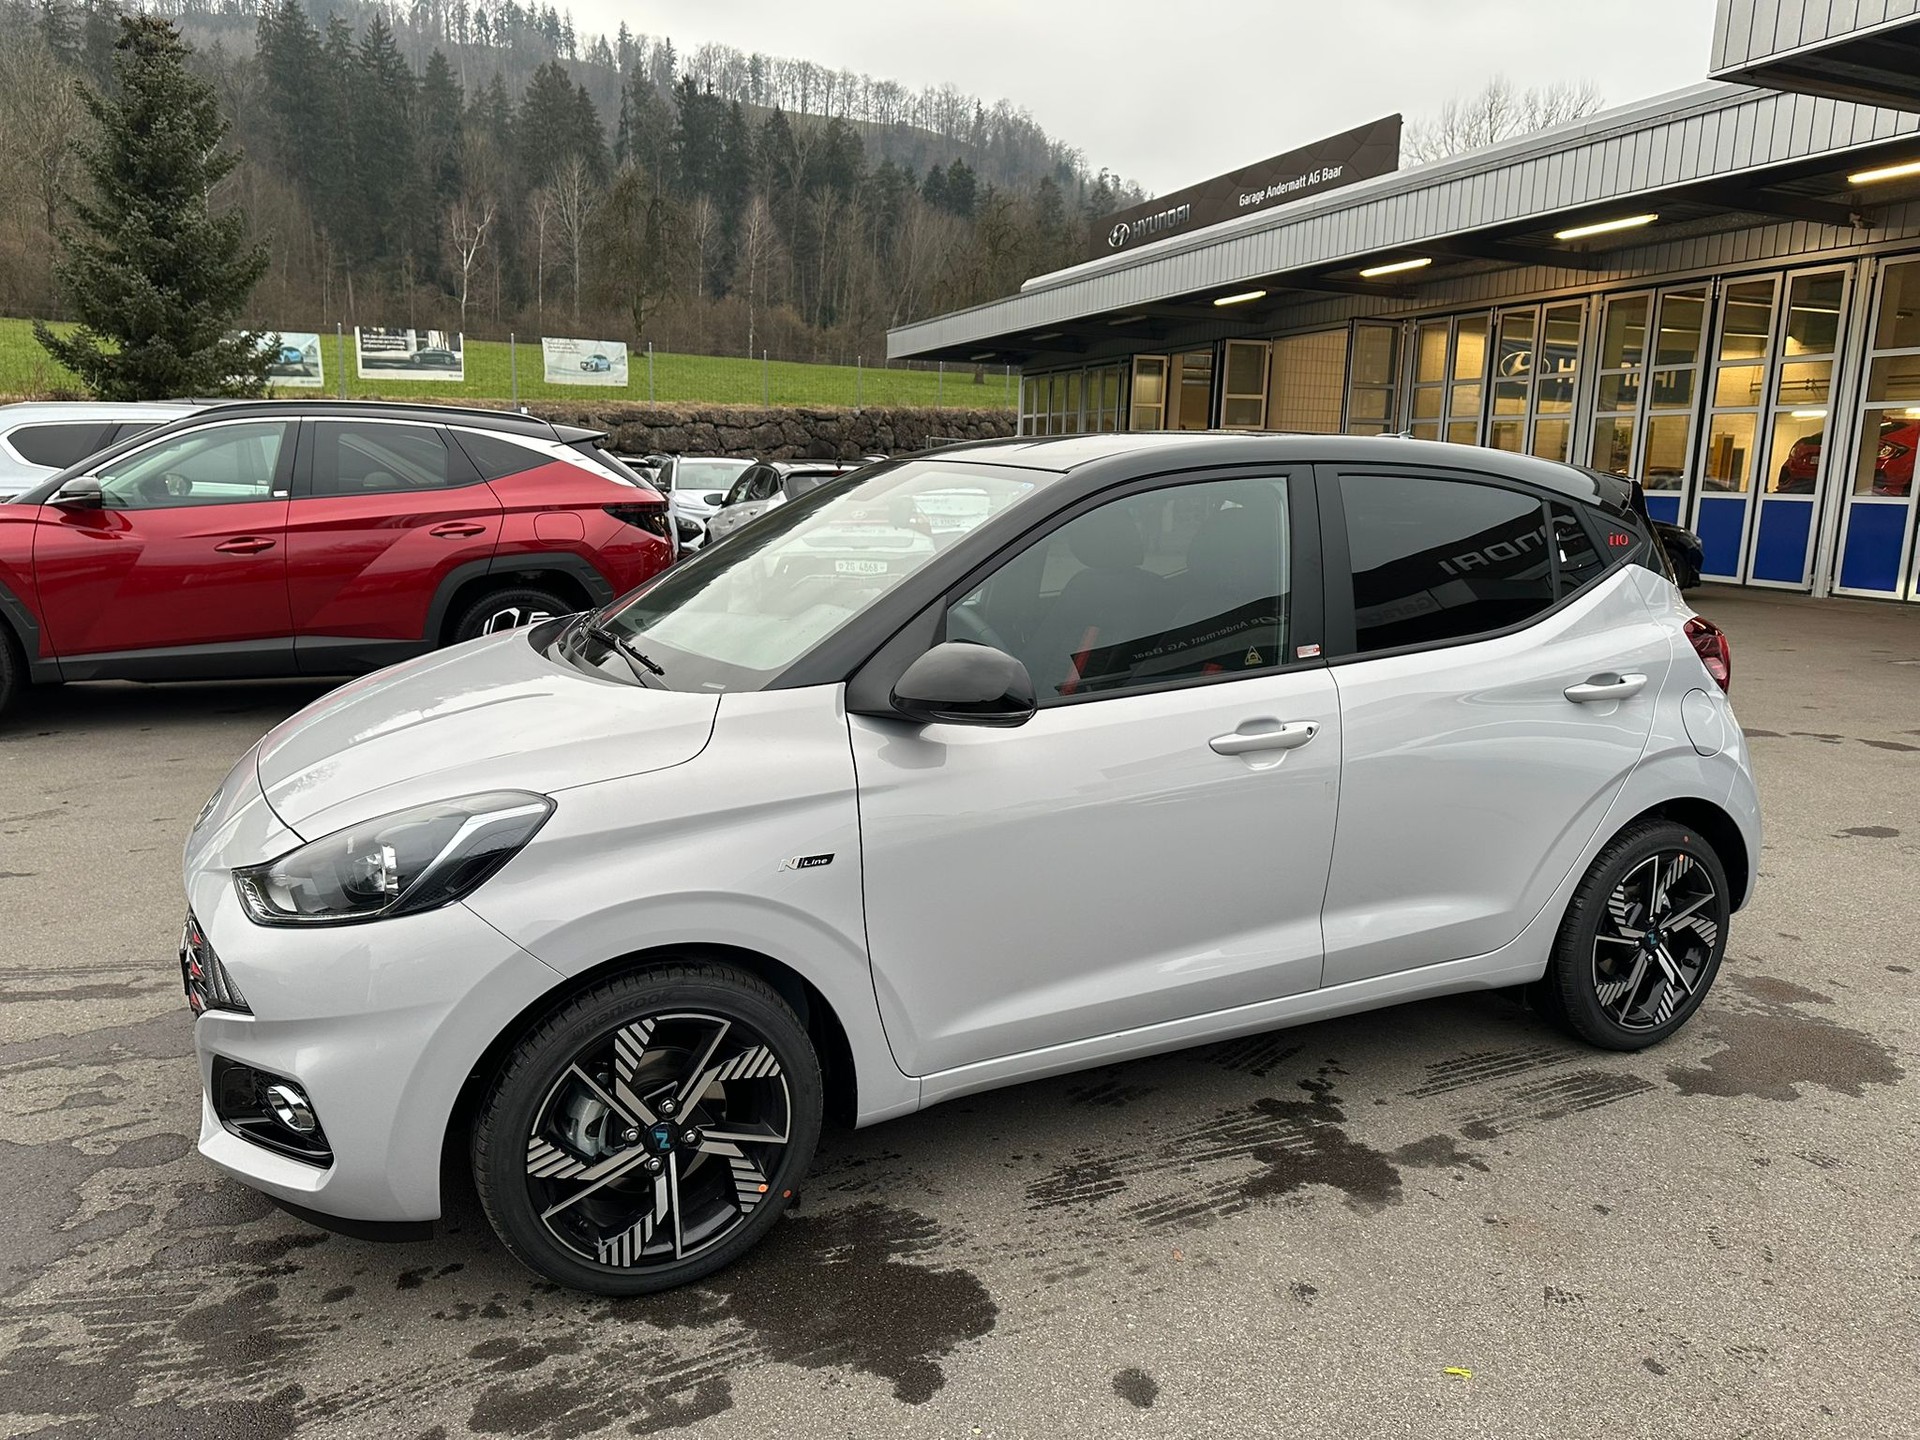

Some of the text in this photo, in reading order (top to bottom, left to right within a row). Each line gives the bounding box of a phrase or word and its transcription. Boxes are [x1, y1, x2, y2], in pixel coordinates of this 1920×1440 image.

[1239, 165, 1343, 206] Garage Andermatt AG Baar
[1132, 203, 1190, 240] HYUNDAI
[1608, 532, 1629, 546] i10
[804, 858, 828, 866] Line
